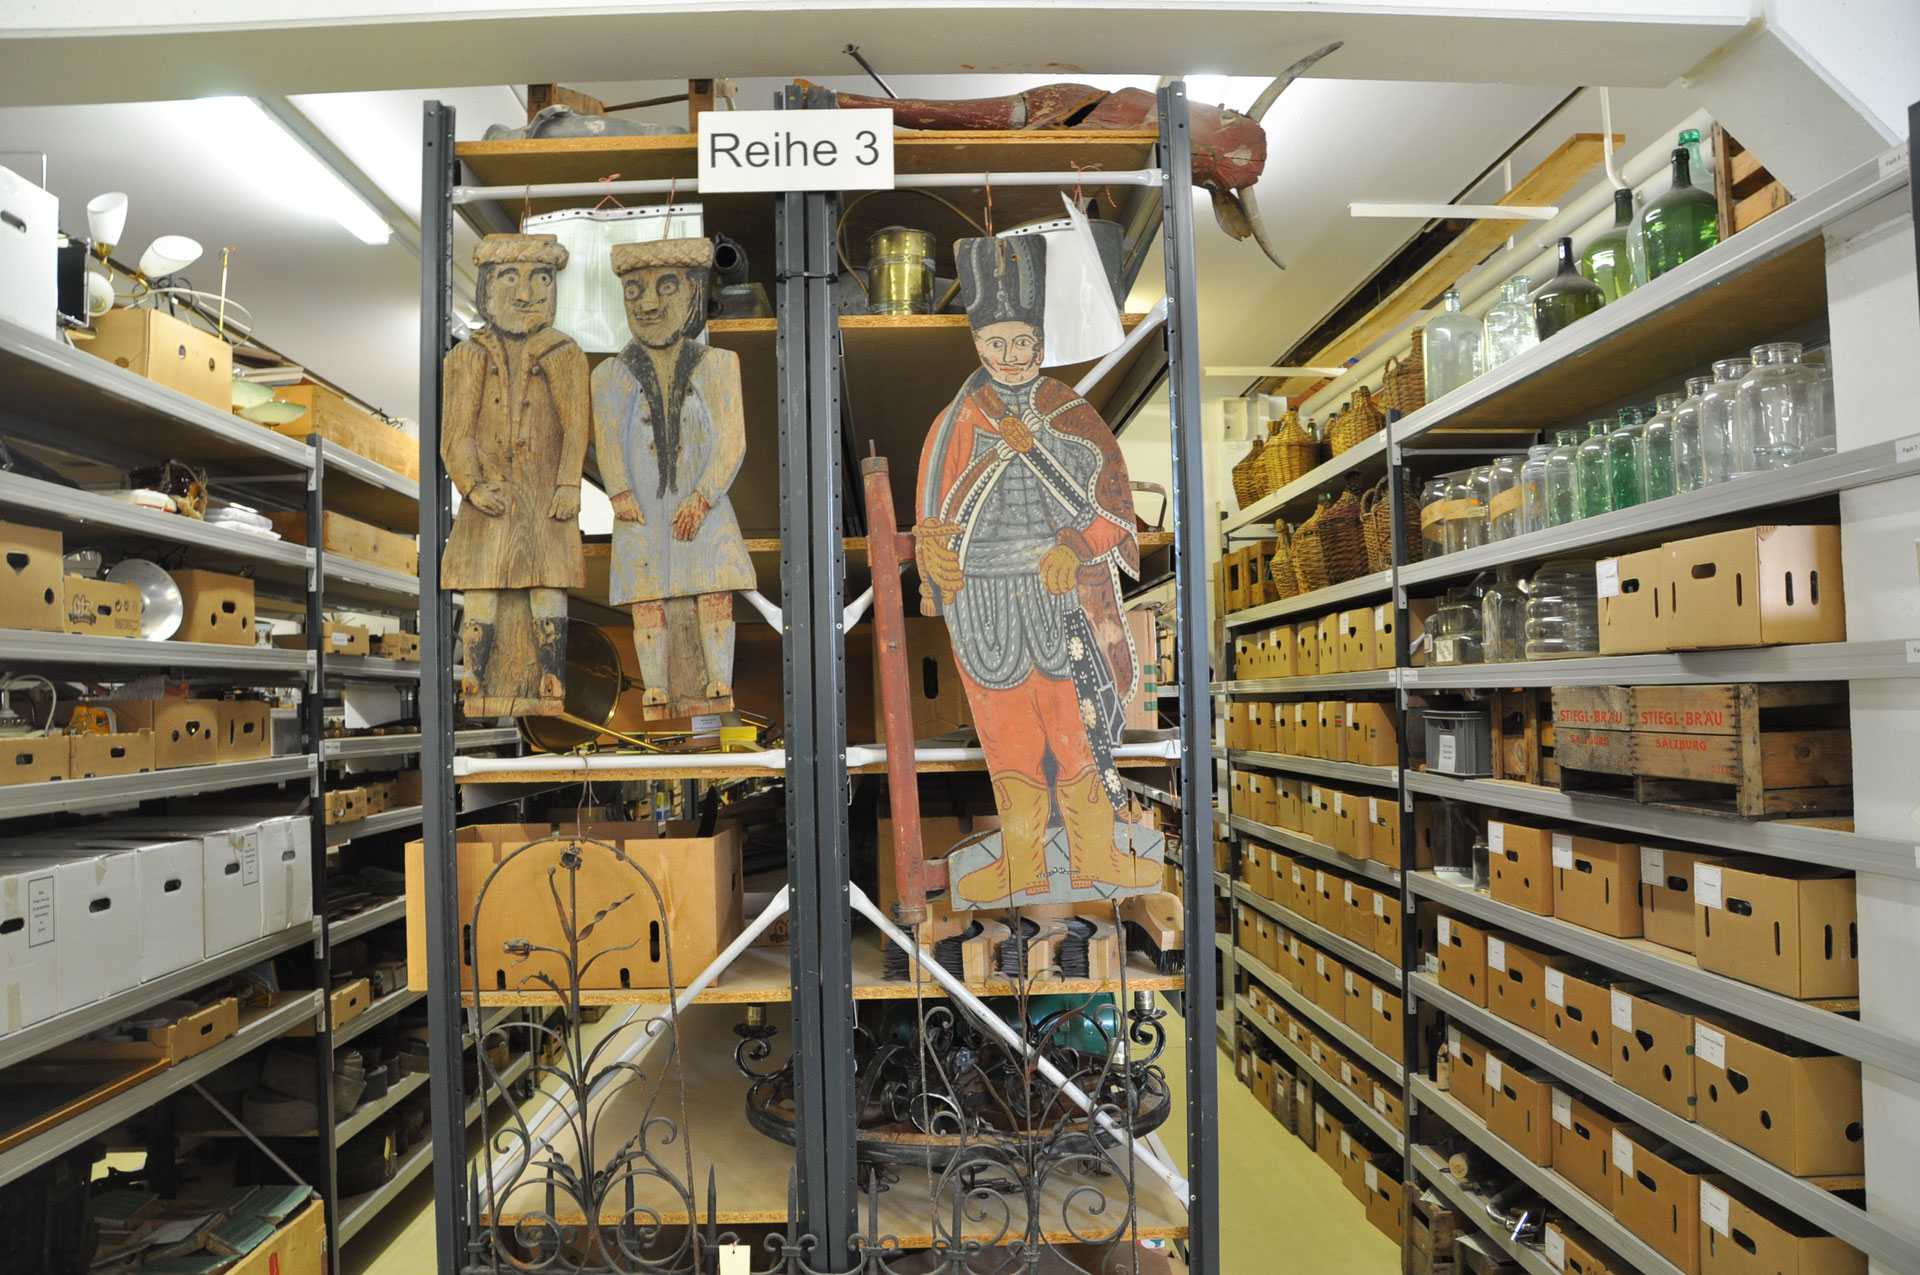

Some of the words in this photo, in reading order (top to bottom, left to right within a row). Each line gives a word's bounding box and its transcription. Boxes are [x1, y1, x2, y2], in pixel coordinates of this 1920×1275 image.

[710, 131, 837, 168] Reihe
[855, 130, 879, 166] 3
[1655, 738, 1708, 751] SALZBURG
